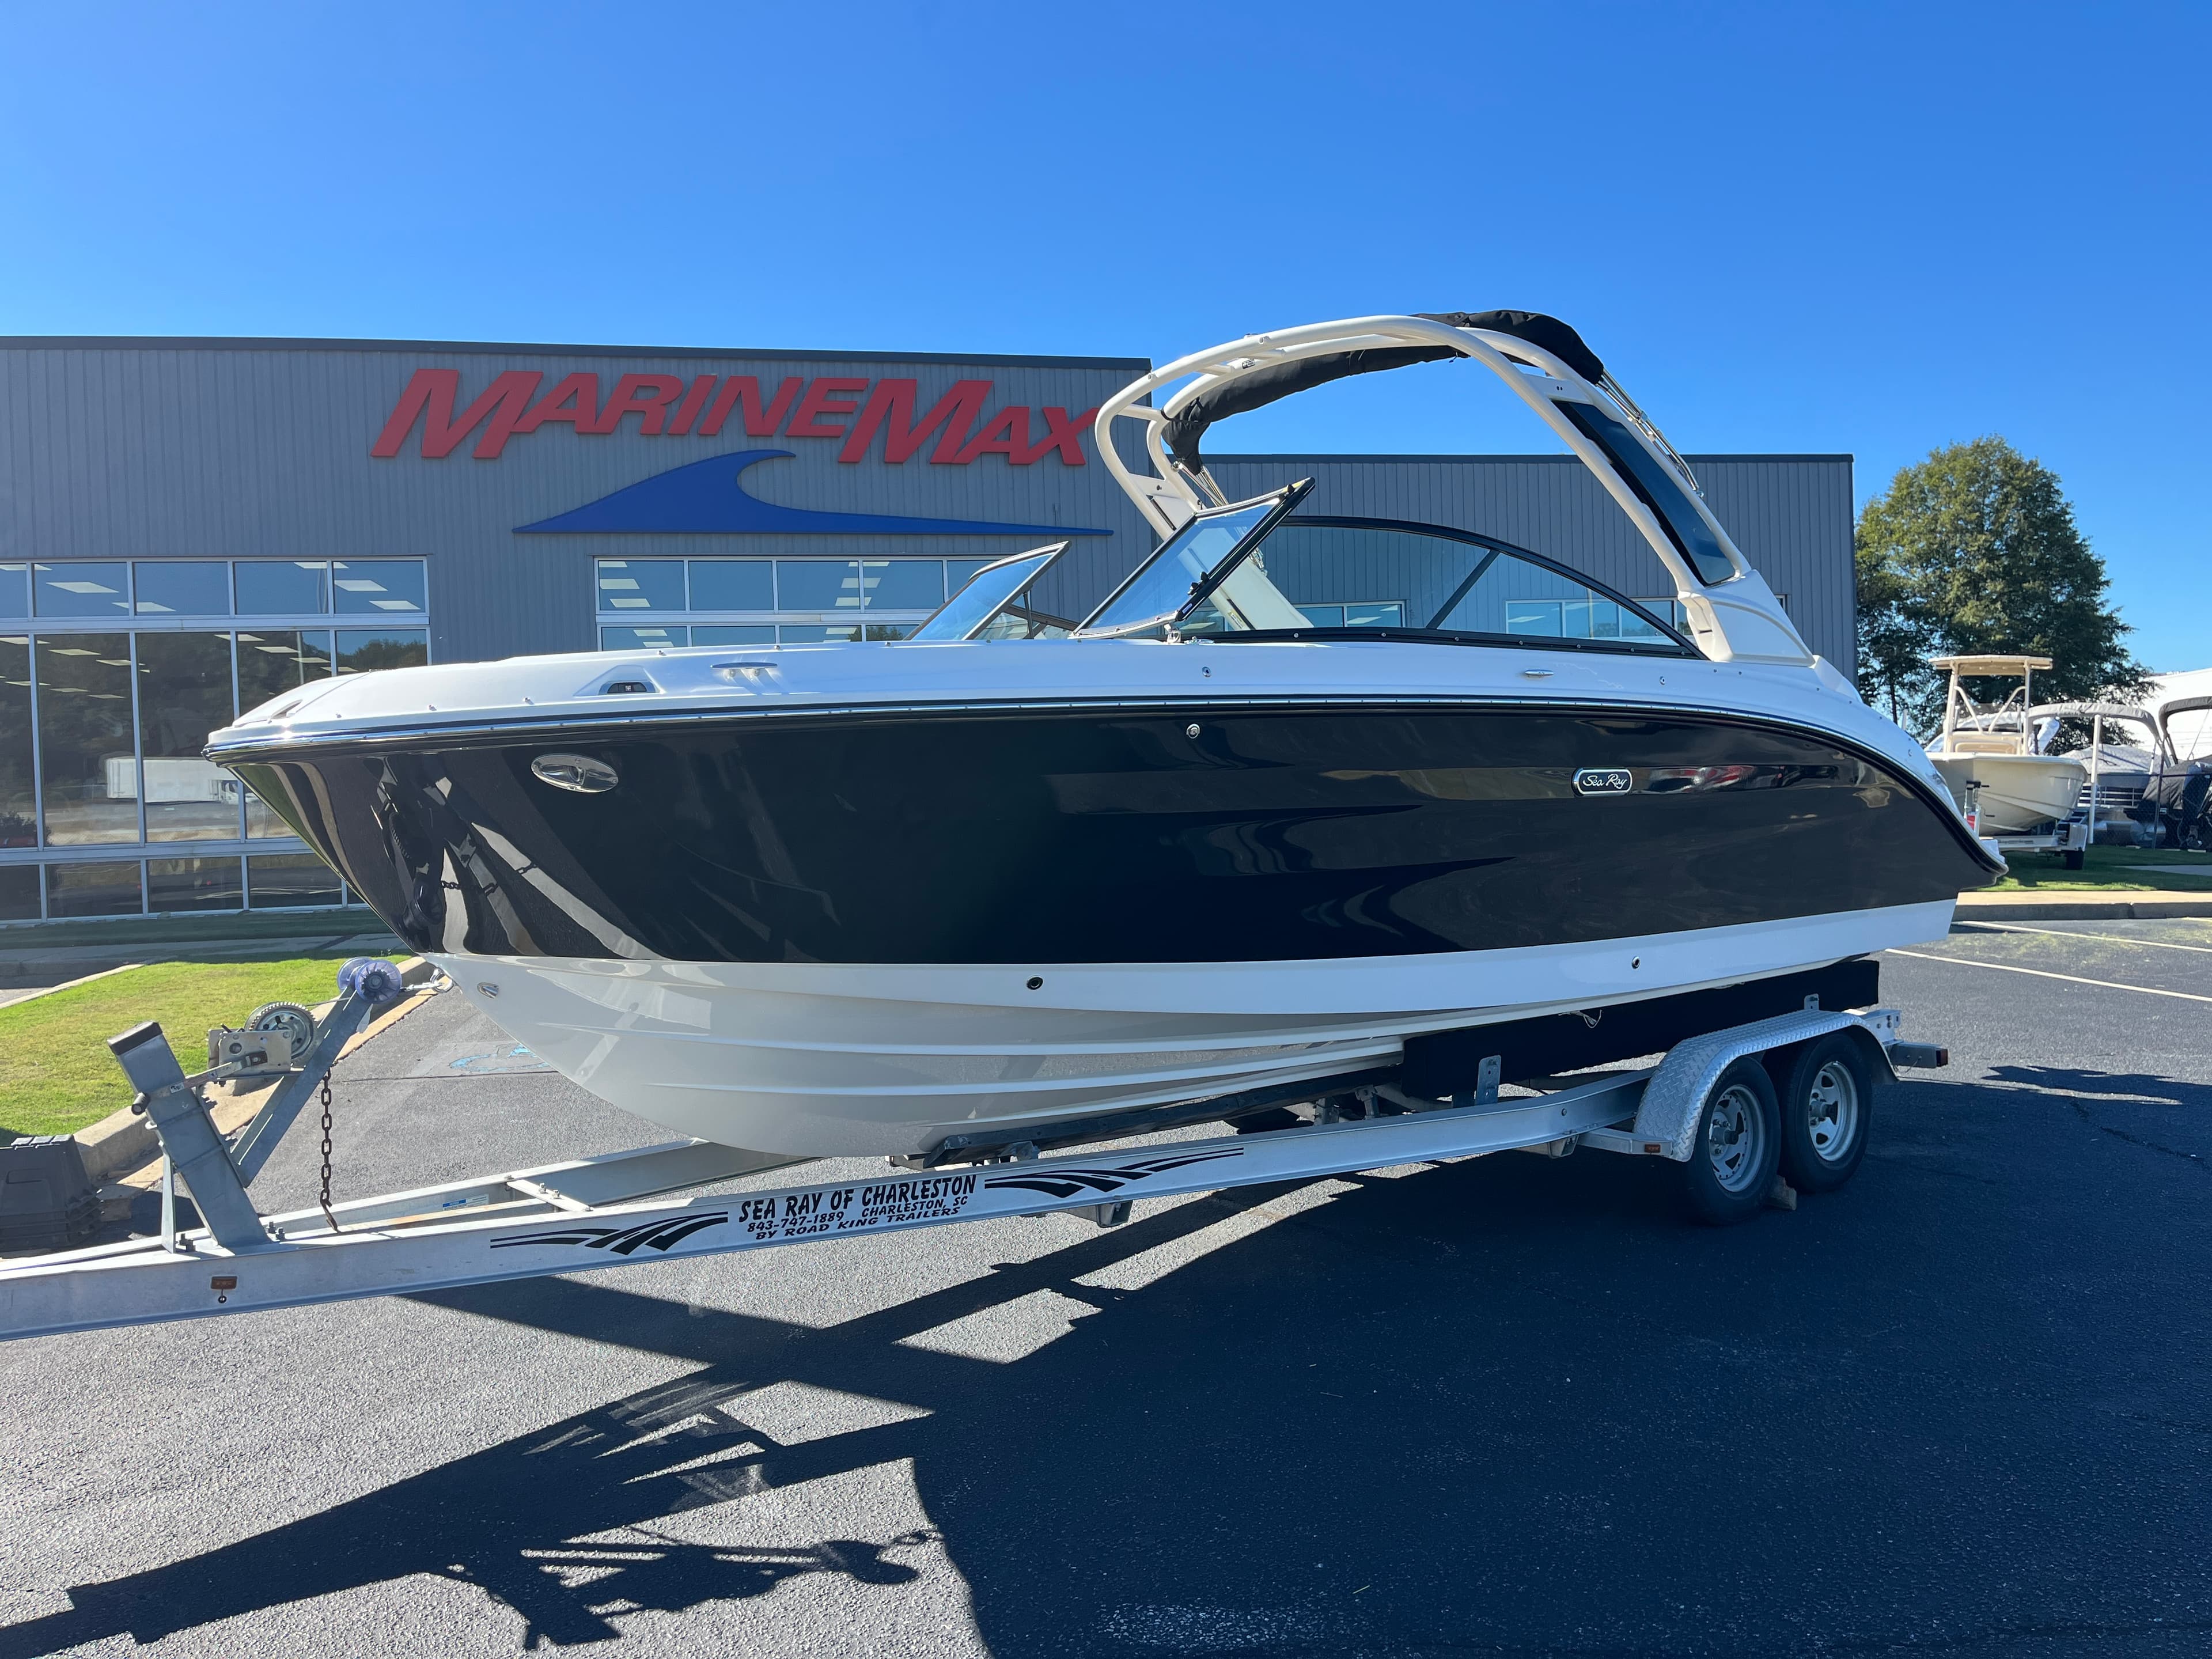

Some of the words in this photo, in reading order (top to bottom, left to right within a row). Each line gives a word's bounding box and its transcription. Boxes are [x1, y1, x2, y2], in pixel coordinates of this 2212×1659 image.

[1582, 775, 1605, 786] Sea
[1605, 774, 1627, 789] Ray
[738, 1198, 776, 1223] SEA
[785, 1192, 823, 1217] RAY
[830, 1188, 854, 1211] OF
[862, 1175, 976, 1207] CHARLESTON
[747, 1211, 844, 1233] 843-747-1889
[861, 1198, 947, 1218] CHARLESTON,
[953, 1195, 968, 1207] SC
[755, 1230, 778, 1240] BY
[784, 1224, 830, 1237] ROAD
[837, 1217, 878, 1229] KING
[887, 1206, 961, 1223] TRAILERS
